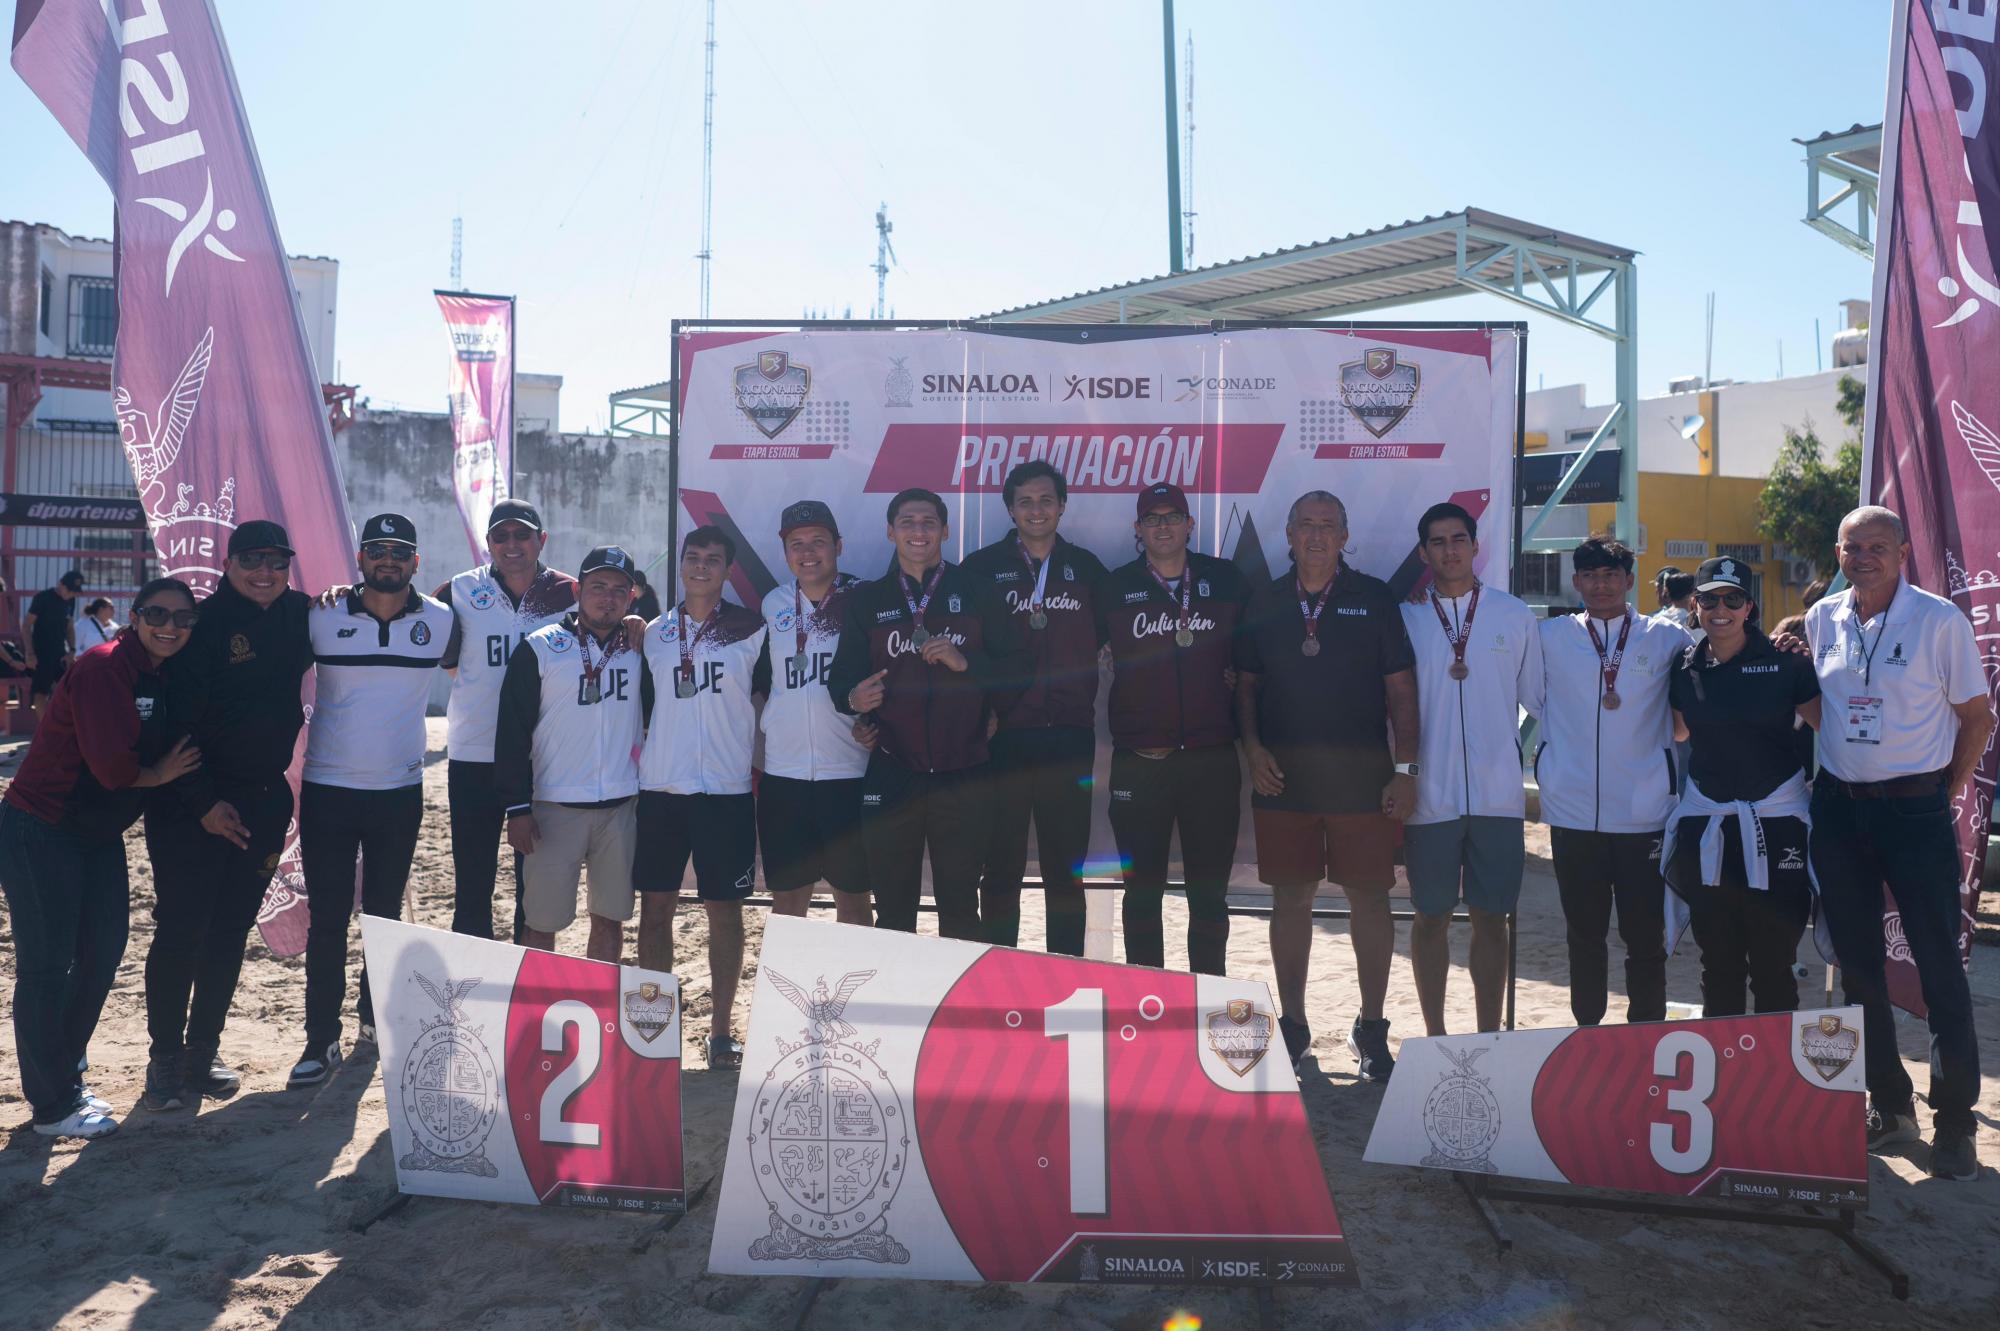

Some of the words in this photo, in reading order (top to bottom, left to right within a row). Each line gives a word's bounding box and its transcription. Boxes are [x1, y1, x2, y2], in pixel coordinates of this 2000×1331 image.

[735, 384, 808, 395] NACIONALES
[922, 374, 1039, 394] SINALOA
[1088, 377, 1150, 399] ISDE
[1206, 377, 1276, 390] CONADE
[1340, 383, 1417, 394] NACIONALES
[735, 395, 806, 409] CONADE
[1341, 394, 1414, 408] CONADE
[742, 446, 767, 458] ETAPA
[768, 446, 800, 458] ESTATAL
[951, 426, 1204, 487] PREMIACIÓN
[1349, 446, 1375, 458] ETAPA
[1376, 445, 1409, 458] ESTATAL
[27, 502, 140, 521] dportenis
[876, 609, 902, 620] IMDEC
[1778, 862, 1805, 870] IMDEM
[431, 1030, 474, 1044] SINALOA
[795, 1051, 862, 1070] SINALOA
[539, 999, 601, 1146] 2
[1448, 1080, 1482, 1090] SINALOA
[1044, 988, 1106, 1213] 1
[1649, 1030, 1717, 1174] 3
[1734, 1183, 1779, 1195] SINALOA
[1796, 1190, 1821, 1201] ISDE
[572, 1194, 609, 1204] SINALOA
[624, 1200, 645, 1209] ISDE
[809, 1219, 848, 1231] 1831
[1104, 1257, 1185, 1274] SINALOA
[1297, 1263, 1346, 1273] CONADE
